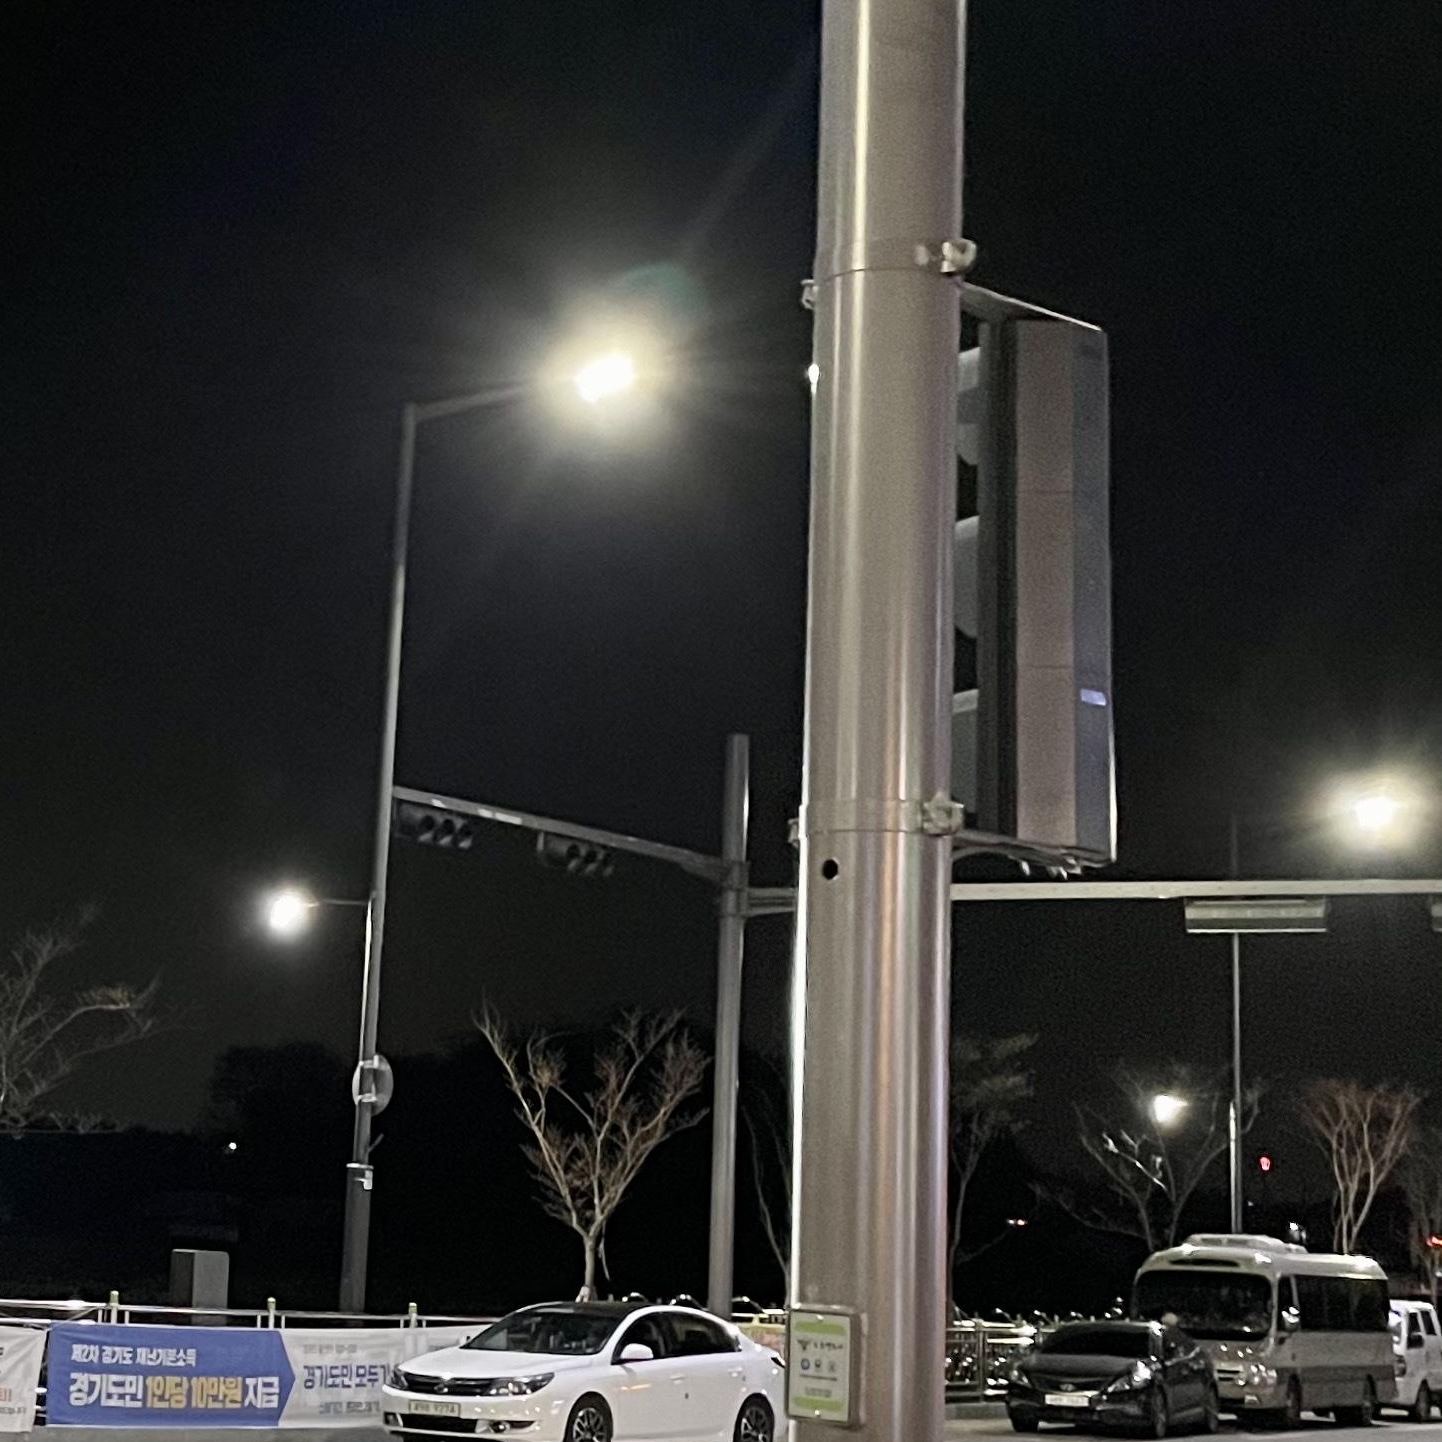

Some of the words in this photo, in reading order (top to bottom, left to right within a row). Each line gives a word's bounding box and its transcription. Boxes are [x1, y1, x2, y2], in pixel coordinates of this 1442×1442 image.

[102, 1345, 133, 1365] 경기도
[303, 1364, 353, 1389] 경기도민
[69, 1372, 144, 1408] 경기도민
[145, 1376, 189, 1409] 1인당
[191, 1376, 243, 1409] 10만원
[244, 1376, 280, 1408] 지급
